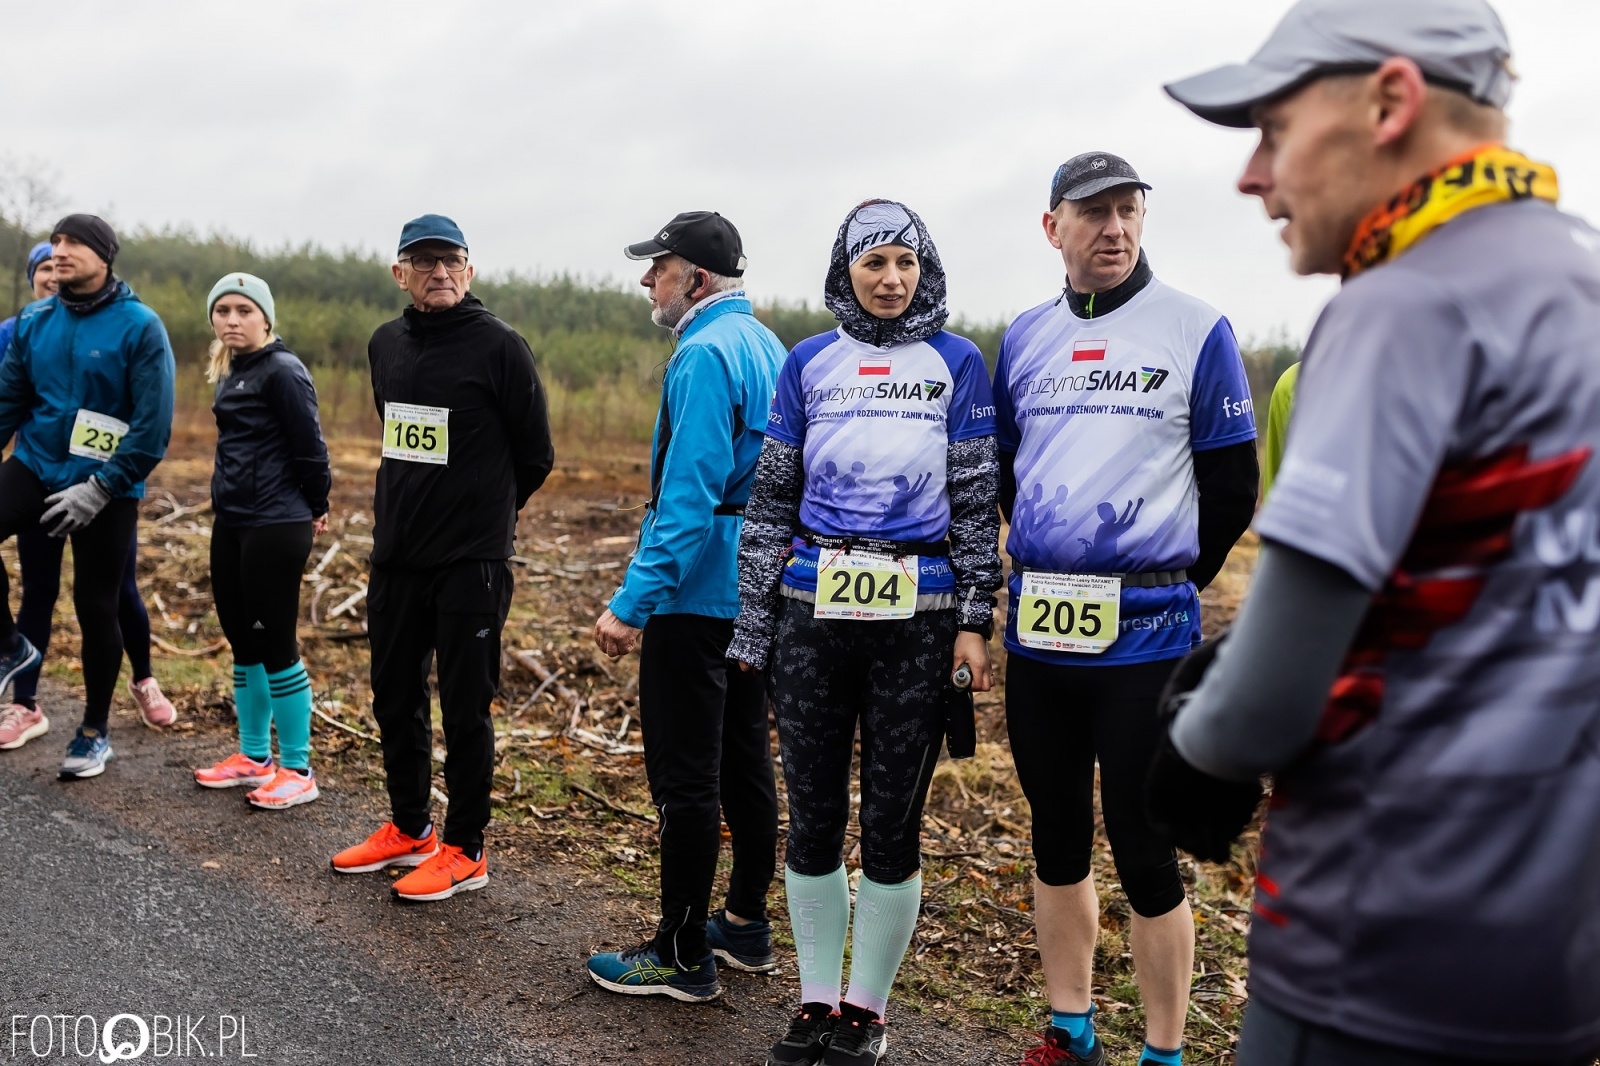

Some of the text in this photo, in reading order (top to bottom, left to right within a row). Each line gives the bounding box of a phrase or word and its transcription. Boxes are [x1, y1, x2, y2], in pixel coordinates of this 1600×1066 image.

[819, 410, 855, 419] POKONAMY
[857, 409, 899, 418] RDZENIOWY
[901, 410, 923, 420] ZANIK
[1027, 406, 1065, 417] POKONAMY
[1066, 404, 1109, 415] RDZENIOWY
[1110, 405, 1134, 416] ZANIK
[1136, 406, 1164, 420] MIĘŚNI
[394, 422, 437, 451] 165
[829, 570, 901, 606] 204
[1031, 599, 1102, 637] 205
